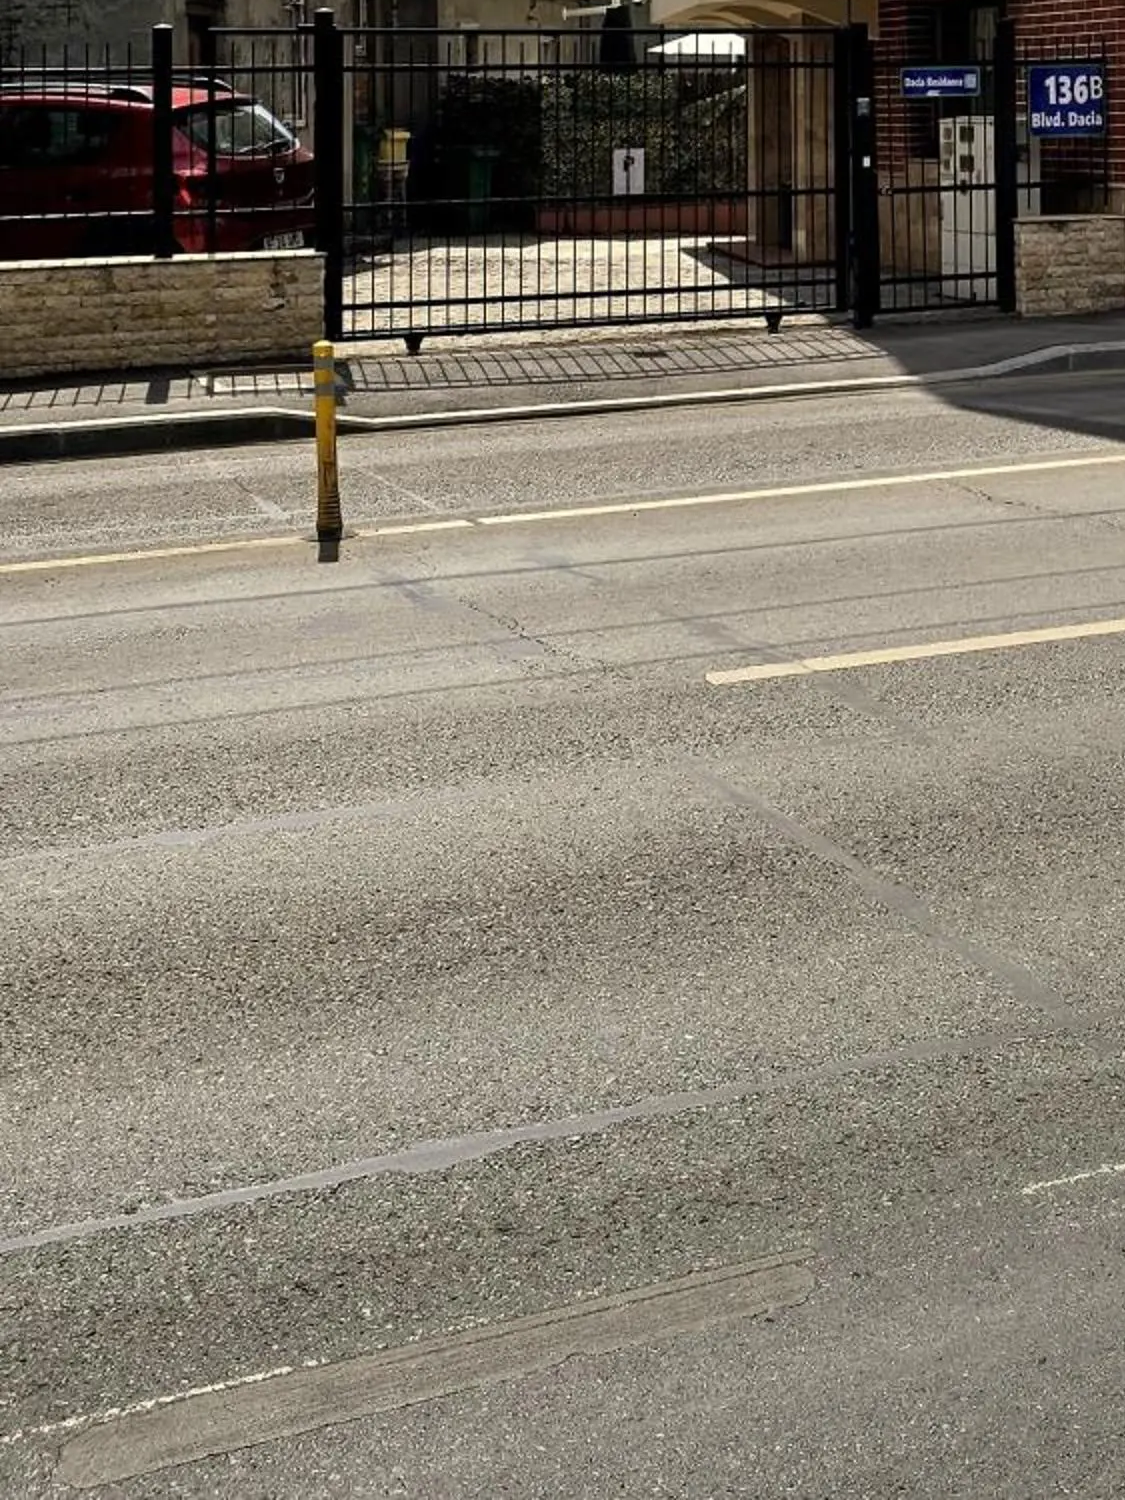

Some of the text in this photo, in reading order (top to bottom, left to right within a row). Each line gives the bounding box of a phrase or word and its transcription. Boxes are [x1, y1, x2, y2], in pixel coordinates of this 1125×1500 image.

[1044, 74, 1103, 105] 136B
[1031, 109, 1103, 128] Blvd. Dacia
